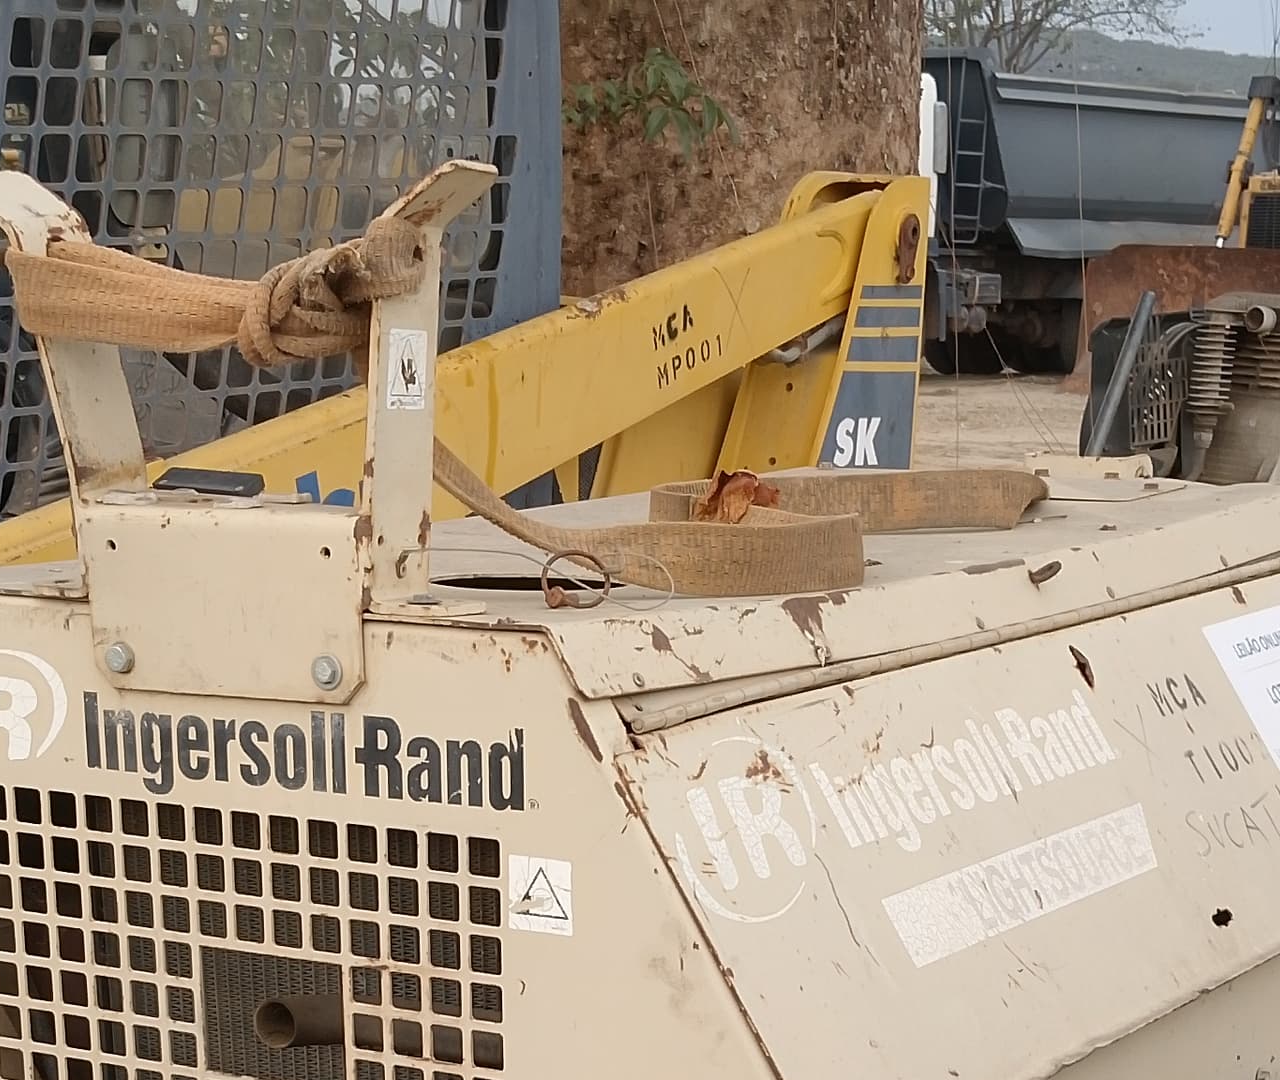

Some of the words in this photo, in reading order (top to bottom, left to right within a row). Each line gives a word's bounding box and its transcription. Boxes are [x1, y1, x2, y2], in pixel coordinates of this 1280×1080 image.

[655, 333, 724, 390] MP001
[832, 416, 883, 468] SK
[685, 775, 808, 891] IR
